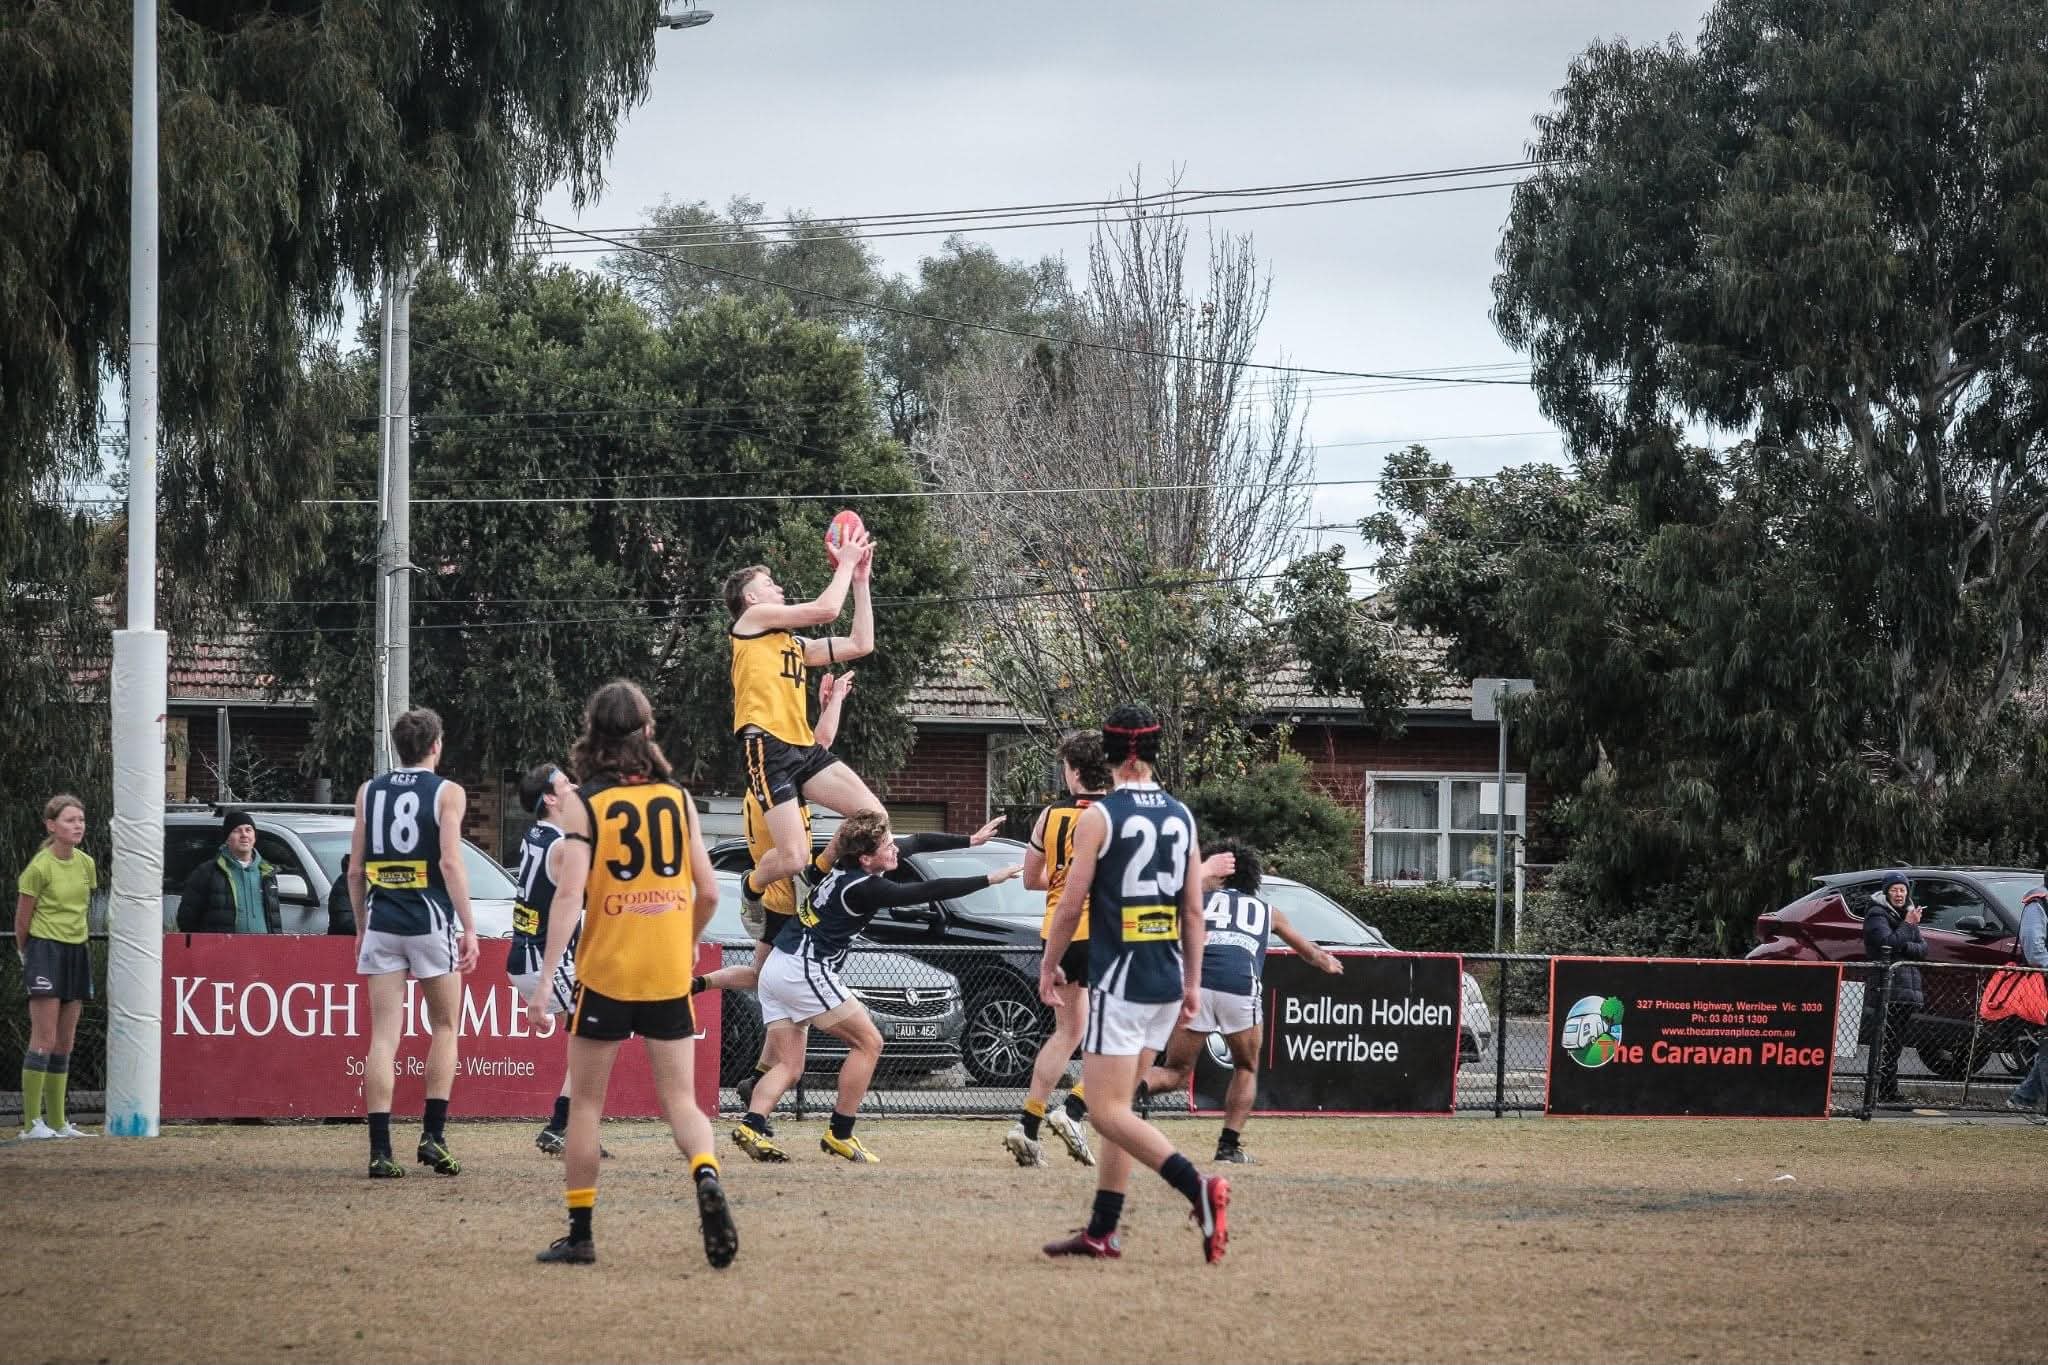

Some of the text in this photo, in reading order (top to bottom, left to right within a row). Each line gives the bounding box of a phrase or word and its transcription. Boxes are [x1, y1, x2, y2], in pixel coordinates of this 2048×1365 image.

[372, 790, 420, 854] 18
[605, 796, 683, 881] 30
[1120, 814, 1189, 897] 23
[603, 888, 688, 917] GODINGS
[1203, 891, 1266, 936] 40
[171, 976, 361, 1037] KEOGH
[1285, 997, 1452, 1026] Ballan Holden
[1636, 1000, 1822, 1013] 327 Princes Highway, Werribee Vic 3030
[1692, 1014, 1768, 1024] Ph: 03 8015 1300
[1661, 1027, 1796, 1038] www.thecaravanplace.com.au
[1285, 1034, 1399, 1062] Werribee
[1598, 1040, 1825, 1066] The Caravan Place
[467, 1056, 535, 1077] Werribee
